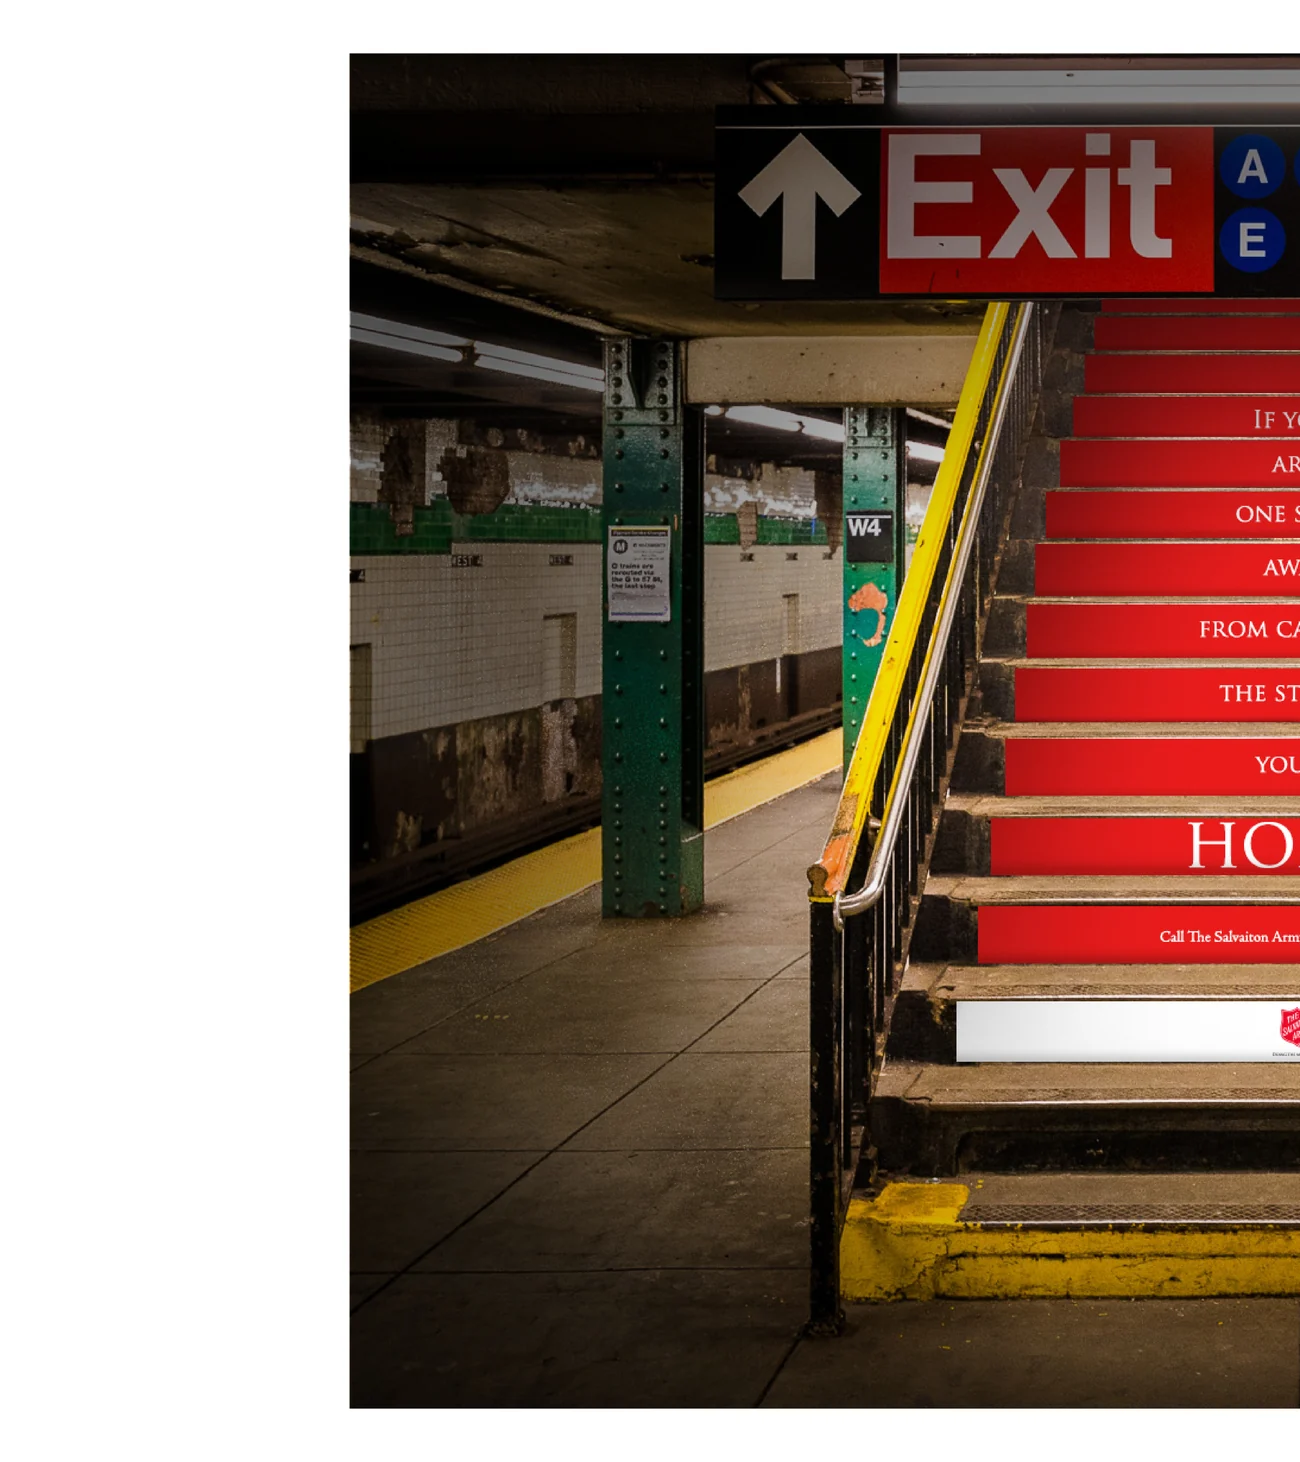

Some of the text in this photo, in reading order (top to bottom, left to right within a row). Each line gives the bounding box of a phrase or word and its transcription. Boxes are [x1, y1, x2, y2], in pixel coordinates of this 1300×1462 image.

[1238, 149, 1268, 184] A
[887, 133, 1172, 258] Exit
[1239, 222, 1267, 257] E
[1235, 505, 1286, 523] ONE
[848, 518, 882, 537] W4
[1200, 620, 1269, 638] FROM
[1219, 684, 1266, 702] THE
[1159, 929, 1185, 943] Call
[1187, 929, 1211, 943] The
[1213, 929, 1269, 943] Salvaiton
[1287, 1012, 1300, 1023] THE
